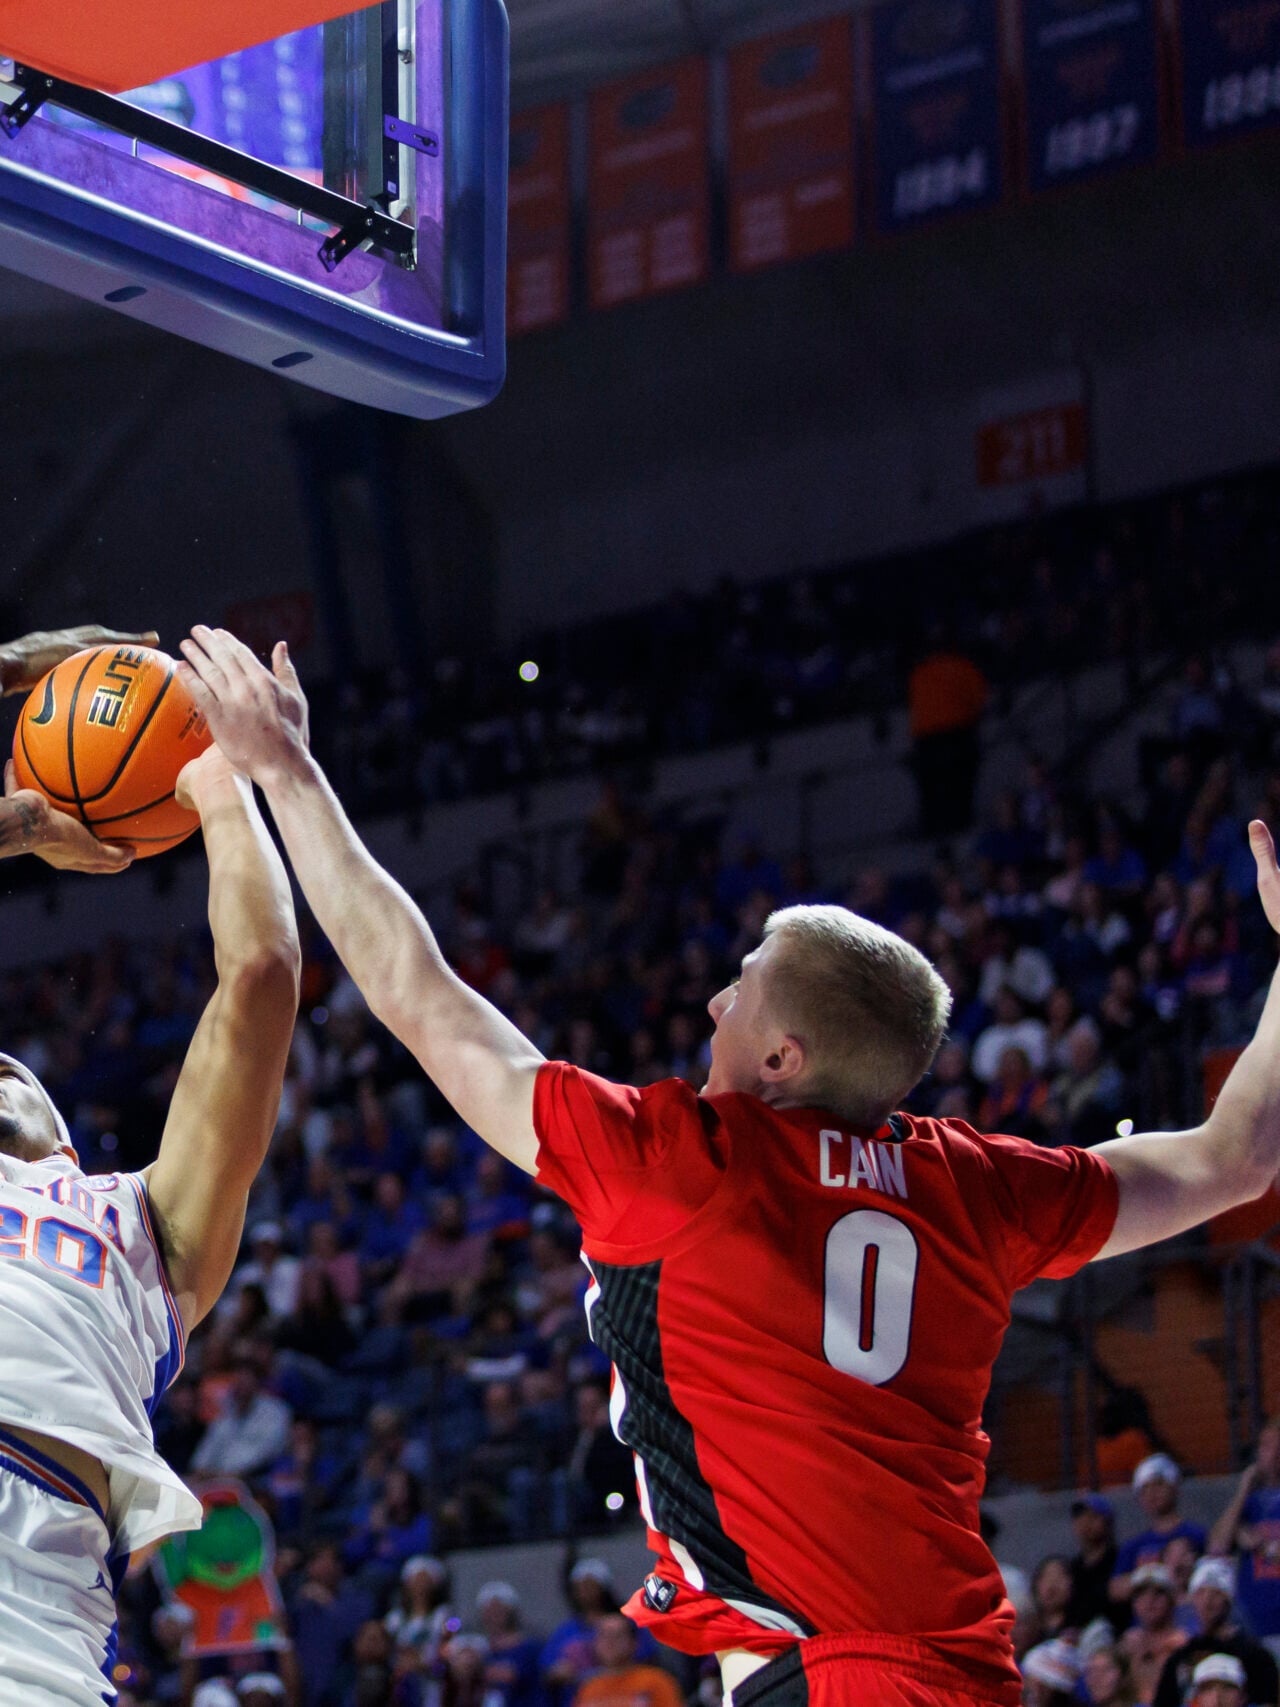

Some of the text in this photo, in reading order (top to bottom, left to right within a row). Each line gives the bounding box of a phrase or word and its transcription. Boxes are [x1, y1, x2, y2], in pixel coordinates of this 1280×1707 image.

[86, 648, 146, 729] ELITE
[819, 1129, 908, 1199] CAIN
[823, 1208, 919, 1386] 0
